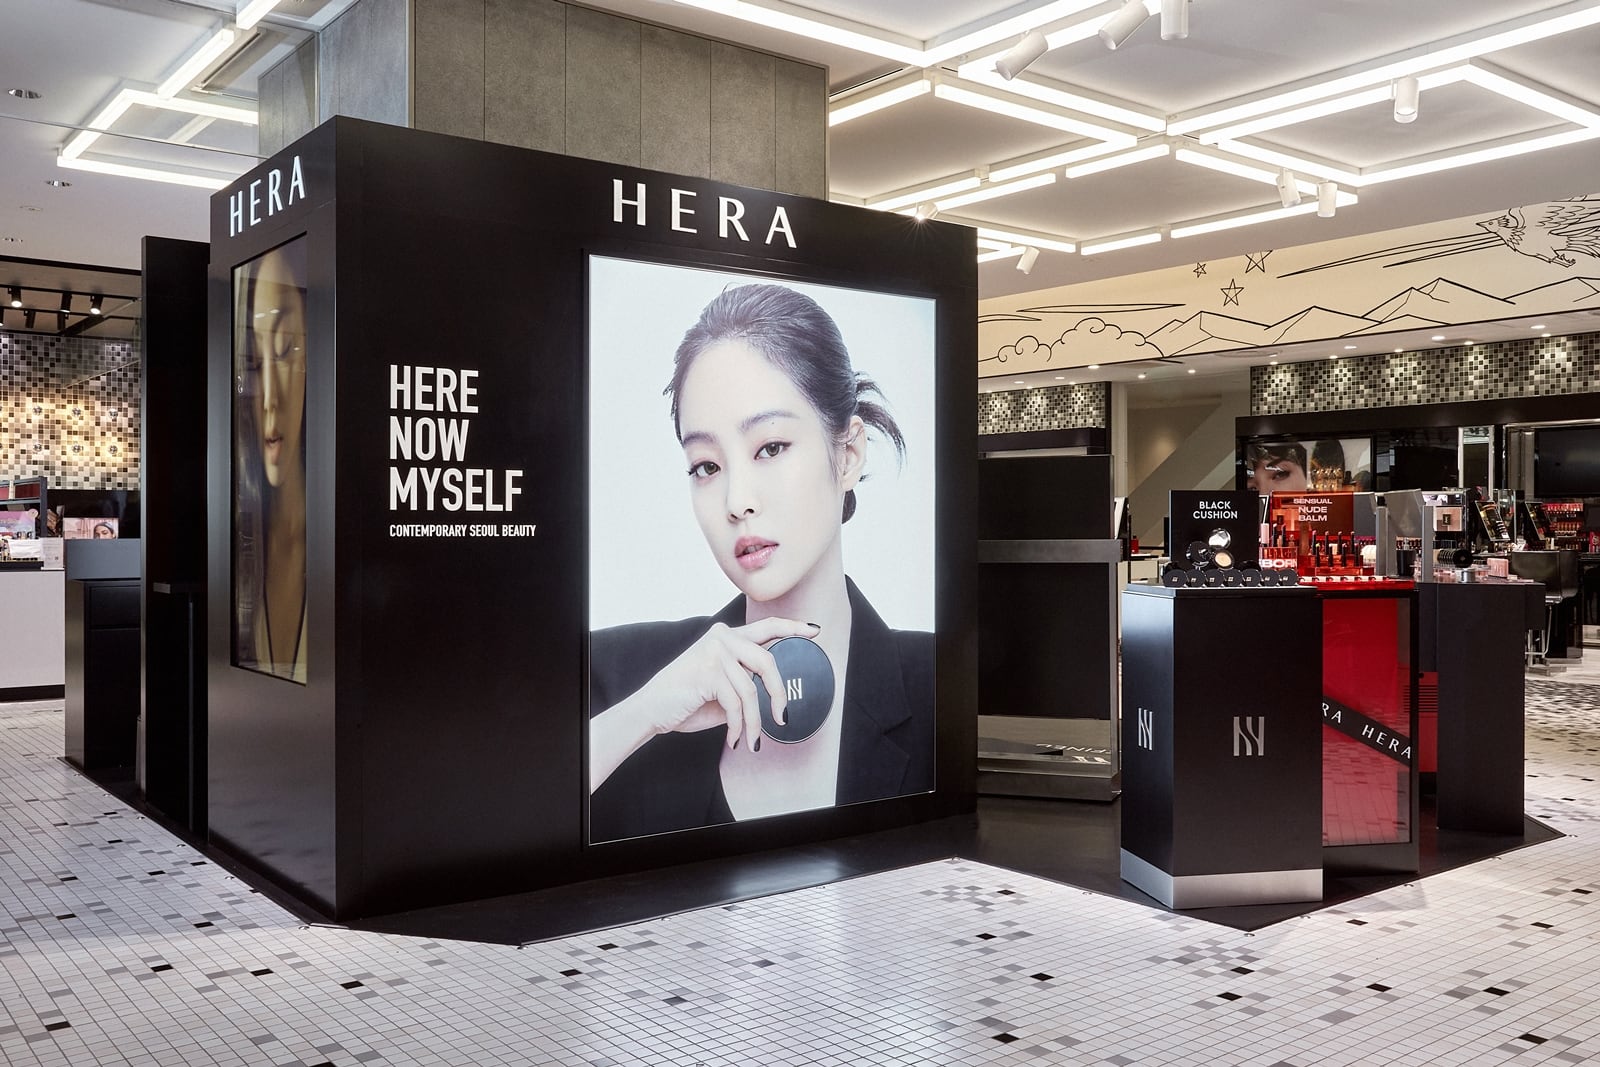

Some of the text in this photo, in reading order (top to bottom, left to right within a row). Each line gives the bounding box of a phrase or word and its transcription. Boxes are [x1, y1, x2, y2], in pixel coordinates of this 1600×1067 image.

[230, 155, 305, 237] HERA
[612, 178, 797, 249] HERA
[390, 364, 479, 414] HERE
[390, 415, 470, 462] NOW
[389, 466, 523, 512] MYSELF
[1199, 501, 1231, 510] BLACK
[1298, 506, 1328, 514] NUDE
[389, 524, 537, 537] CONTEMPORARY SEOUL BEAUTY
[1193, 510, 1238, 520] CUSHION
[1322, 702, 1412, 760] RA HERA
